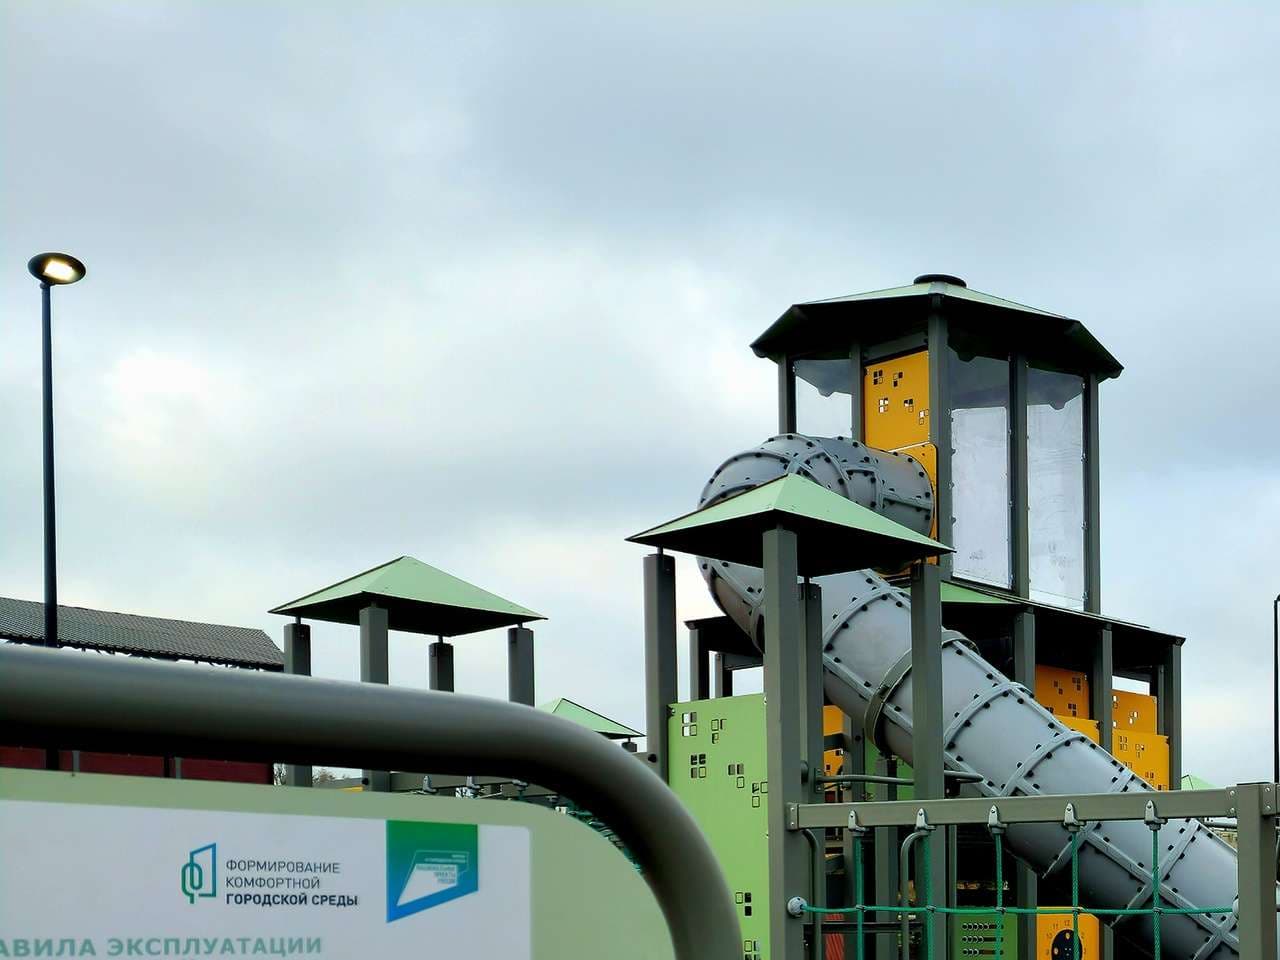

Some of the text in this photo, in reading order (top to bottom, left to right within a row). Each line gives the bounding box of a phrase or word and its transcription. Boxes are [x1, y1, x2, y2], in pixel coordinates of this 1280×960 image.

[226, 859, 340, 874] ФОРМИРОВАНИЕ
[226, 876, 320, 889] КОМФОРТНОЙ
[226, 892, 358, 908] ГОРОДСКОЙ СРЕДЫ
[107, 938, 321, 957] ЭКСПЛУАТАЦИИ
